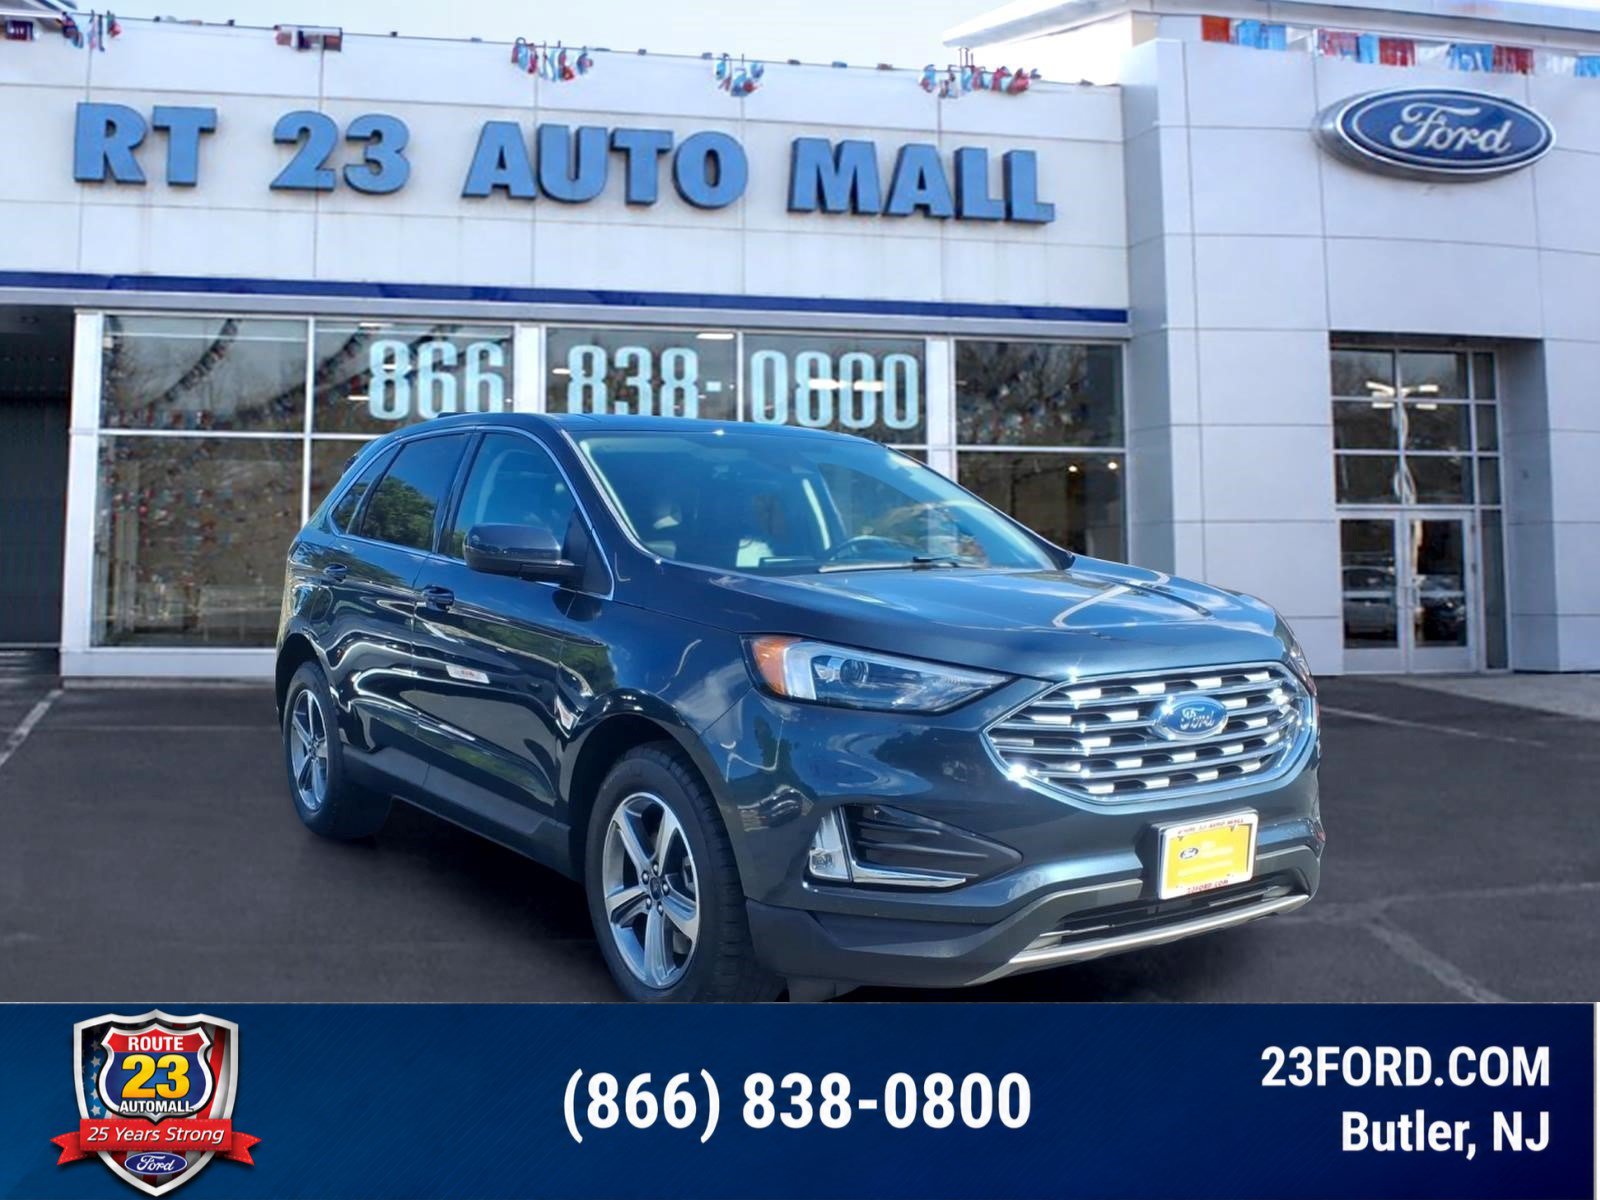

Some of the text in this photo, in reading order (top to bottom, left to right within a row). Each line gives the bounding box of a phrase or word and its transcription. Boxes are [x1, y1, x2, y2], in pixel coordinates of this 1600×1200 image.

[1389, 102, 1513, 152] Ford
[73, 101, 1056, 224] RT 23 AUTO MALL
[369, 339, 504, 420] 866
[1180, 706, 1216, 730] Ford
